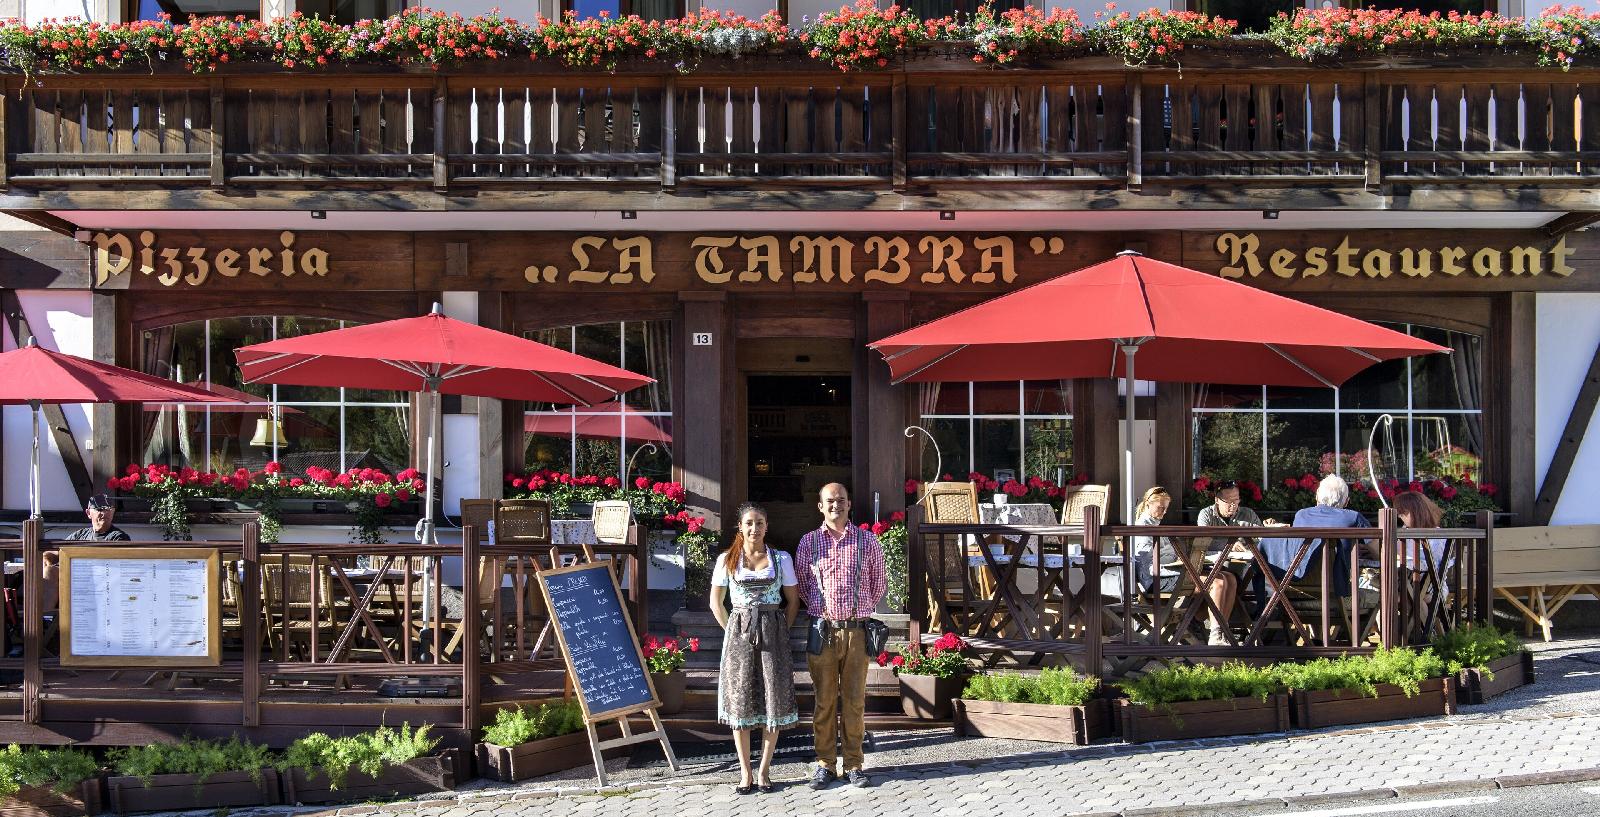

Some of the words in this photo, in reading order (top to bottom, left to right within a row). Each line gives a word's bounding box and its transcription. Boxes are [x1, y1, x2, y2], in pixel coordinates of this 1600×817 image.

[93, 230, 330, 287] Pizzeria
[1216, 232, 1577, 279] Restaurant
[696, 334, 709, 344] 13
